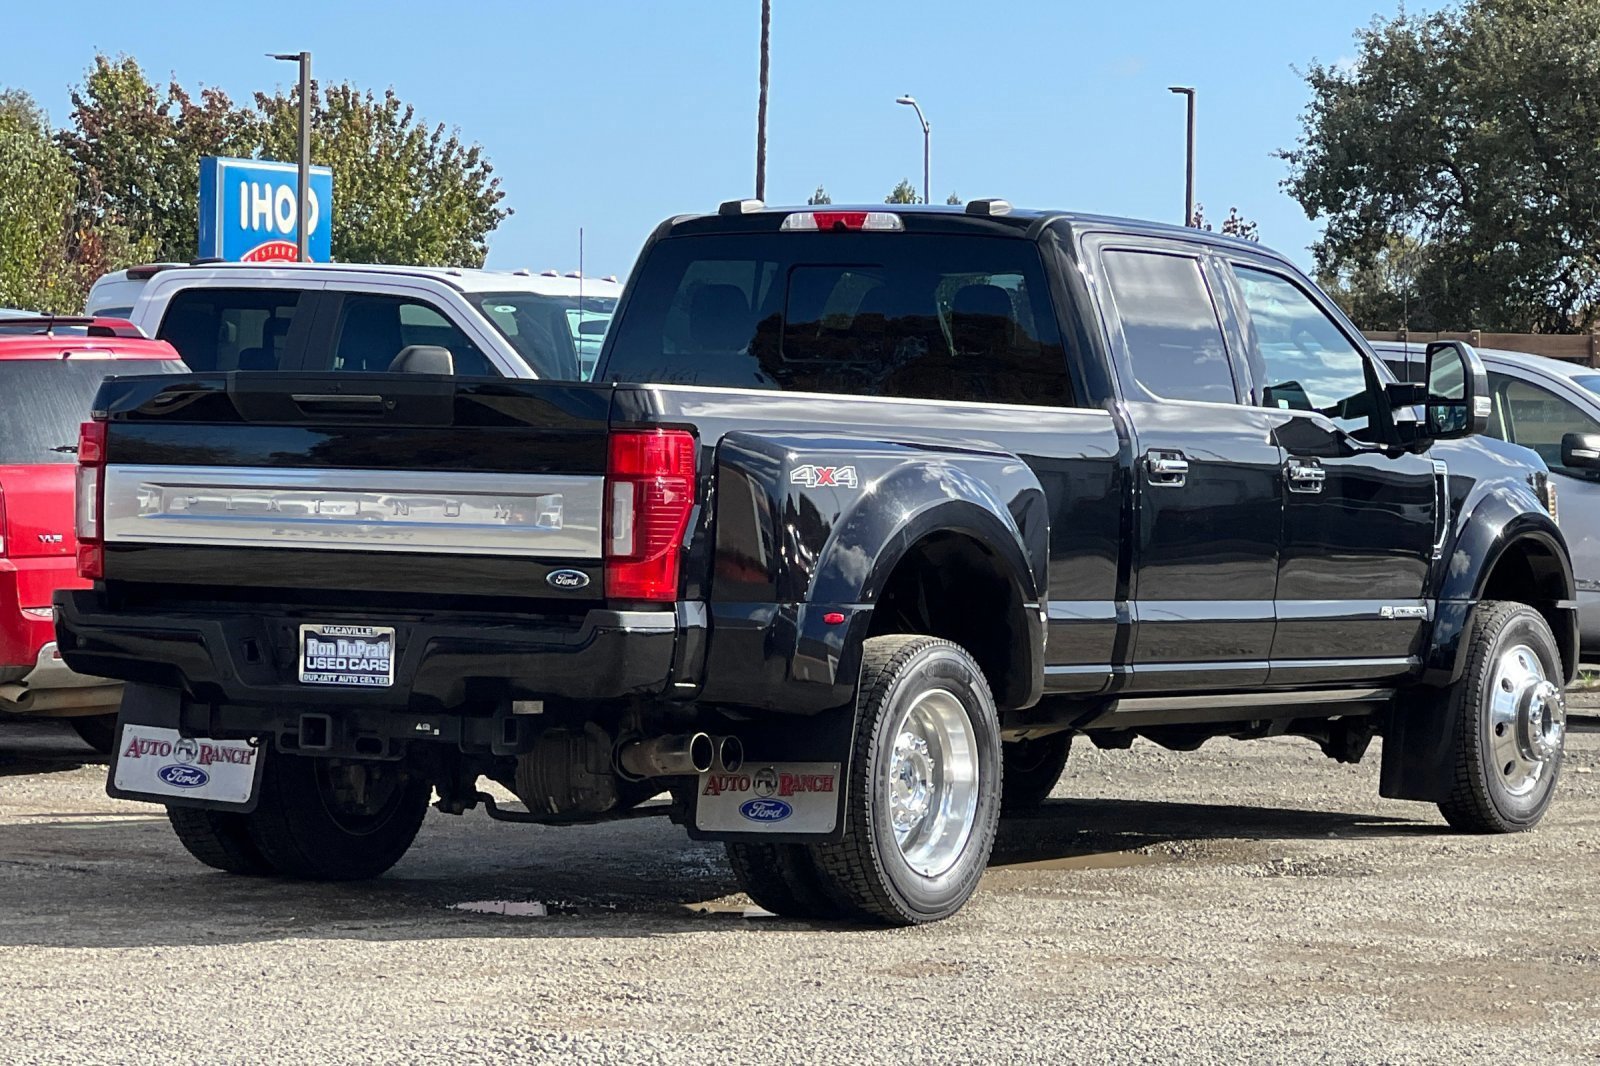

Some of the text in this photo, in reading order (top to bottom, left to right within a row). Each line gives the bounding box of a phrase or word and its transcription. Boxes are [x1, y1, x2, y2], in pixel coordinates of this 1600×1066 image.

[246, 246, 299, 262] ESTAUR
[323, 627, 373, 635] VACAVILLE
[306, 638, 390, 660] Ron DuPratt
[306, 657, 390, 672] USED CARS
[338, 675, 359, 683] AUTO
[124, 736, 256, 765] AUTO RANCH
[166, 767, 202, 784] Ford
[702, 773, 836, 796] AUTO RANCH
[748, 801, 783, 818] Ford
